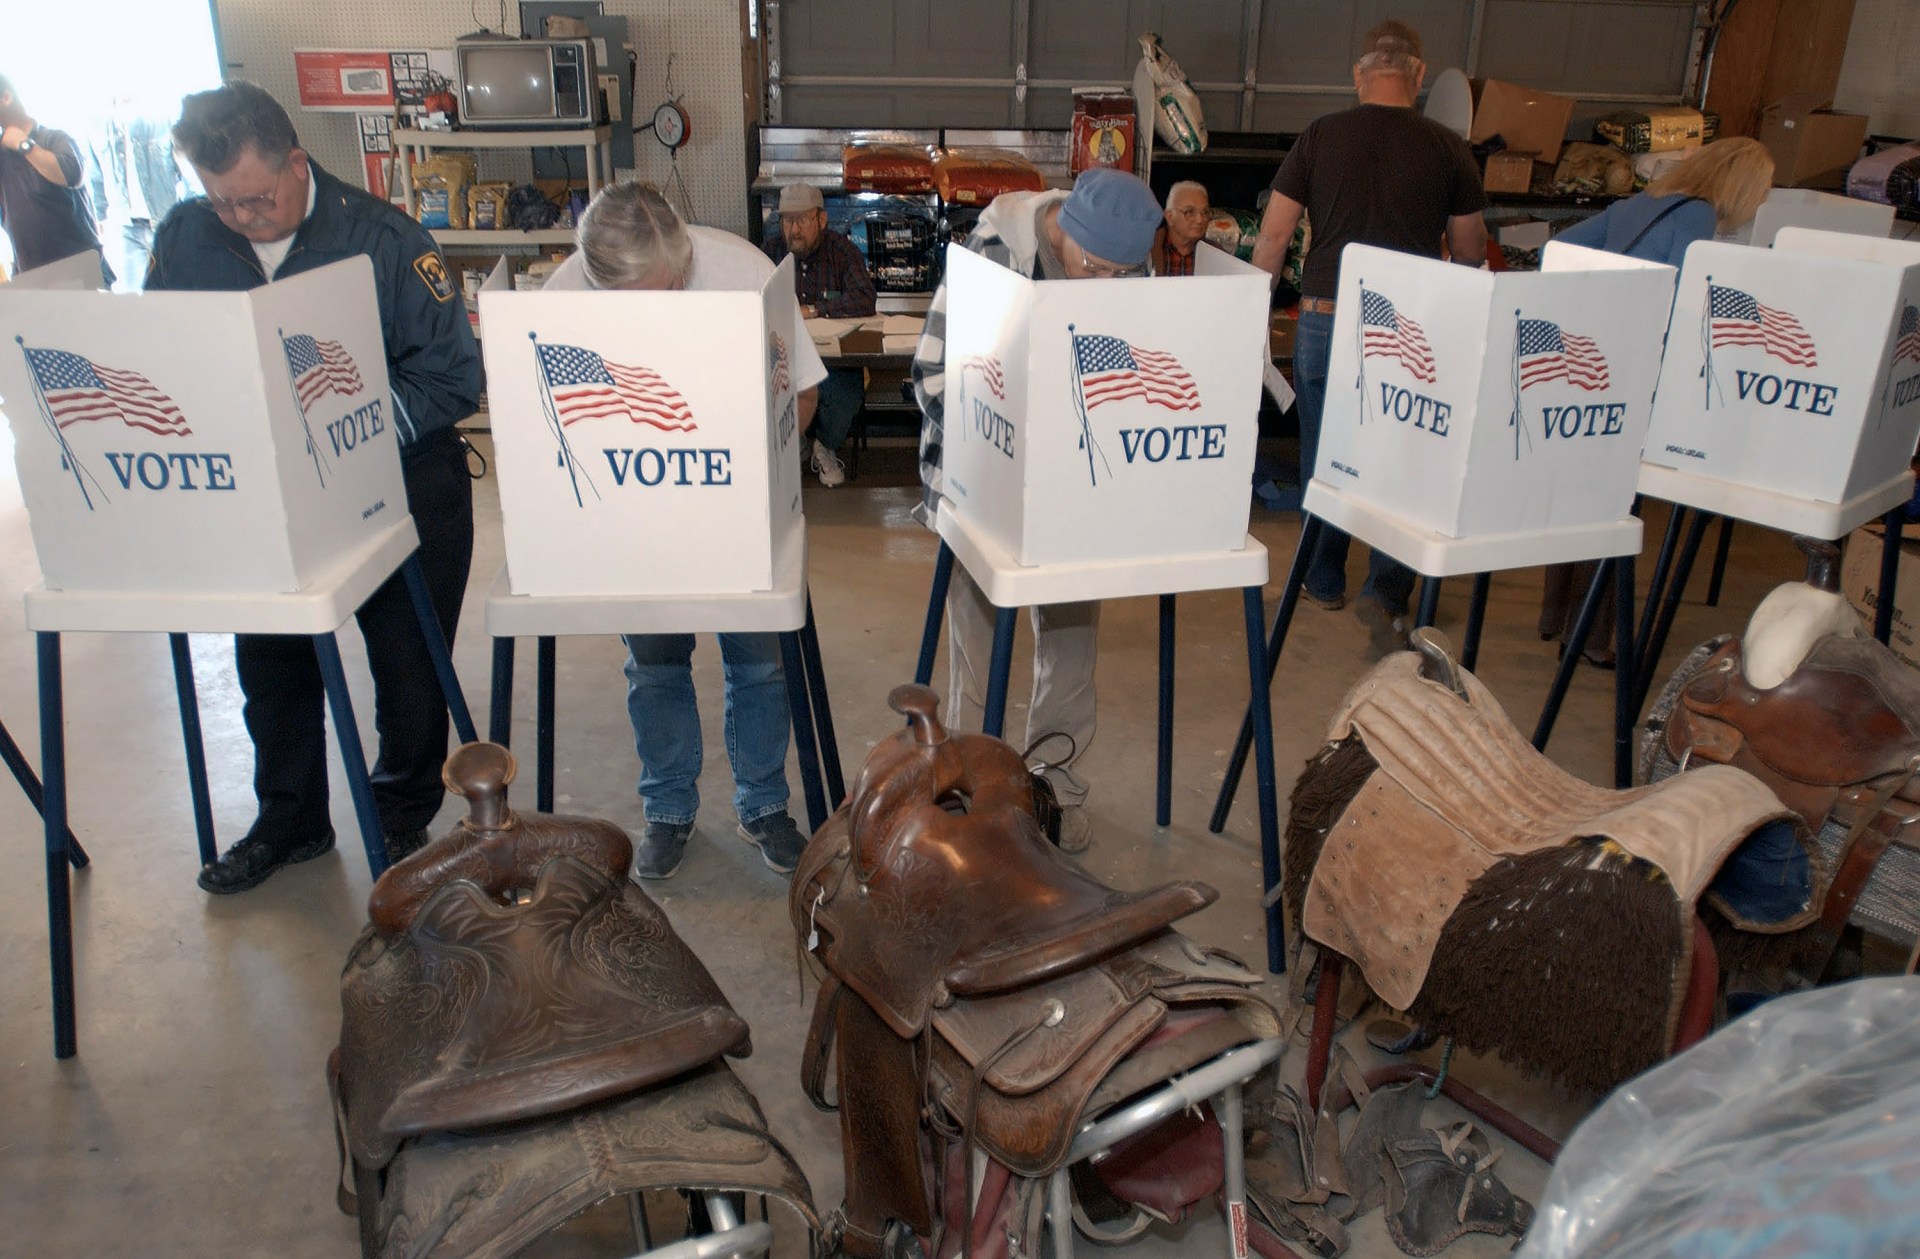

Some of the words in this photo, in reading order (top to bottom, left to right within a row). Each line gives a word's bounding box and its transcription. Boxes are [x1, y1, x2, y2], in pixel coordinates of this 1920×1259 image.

[1381, 381, 1452, 437] VOTE
[1736, 369, 1838, 416] VOTE
[326, 398, 386, 458] VOTE
[973, 396, 1015, 459] VOTE
[1541, 403, 1627, 440] VOTE
[1119, 424, 1227, 463] VOTE
[105, 452, 237, 491] VOTE
[603, 447, 732, 487] VOTE
